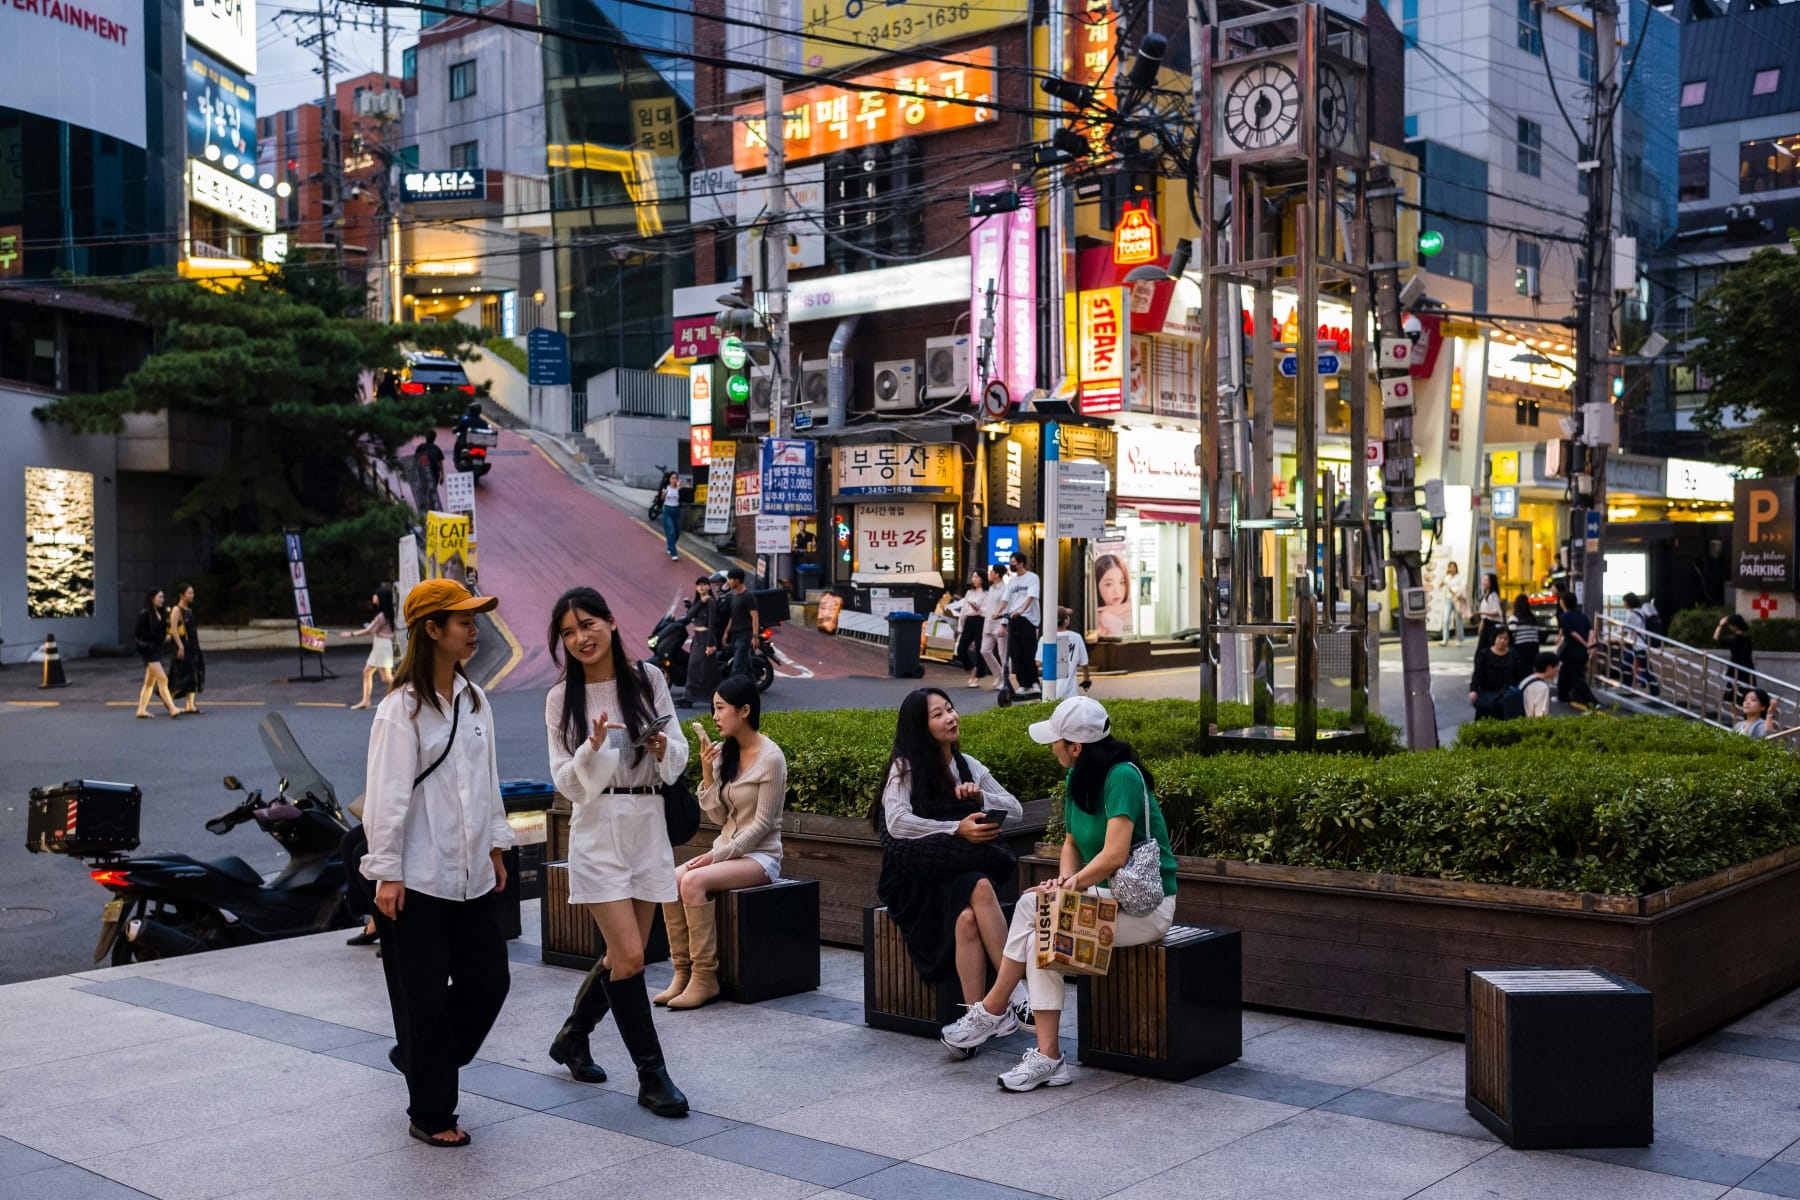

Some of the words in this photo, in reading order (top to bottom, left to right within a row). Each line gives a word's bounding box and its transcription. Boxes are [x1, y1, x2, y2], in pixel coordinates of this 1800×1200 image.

[1094, 297, 1117, 372] STEAK!
[851, 447, 930, 480] 부동산
[1006, 439, 1022, 509] STEAK!
[860, 506, 887, 516] 24시간
[1748, 489, 1780, 544] P
[440, 523, 468, 539] CAT
[441, 540, 465, 549] CAFE
[895, 561, 915, 574] 5m
[1740, 564, 1785, 577] PARKING
[1039, 904, 1051, 952] LUSH
